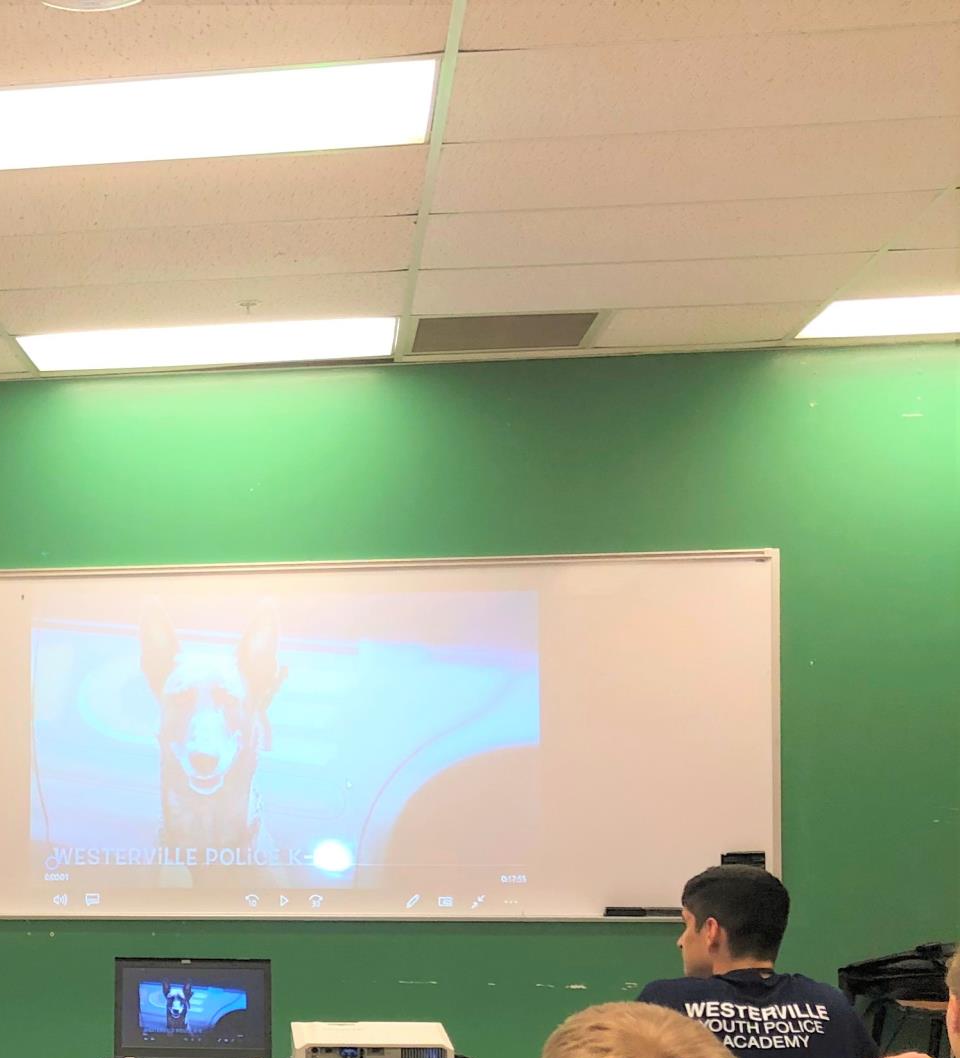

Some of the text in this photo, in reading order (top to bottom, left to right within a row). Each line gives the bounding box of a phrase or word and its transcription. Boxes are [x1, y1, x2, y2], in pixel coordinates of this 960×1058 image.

[684, 1002, 830, 1022] WESTERVILLE
[763, 1020, 825, 1035] POLICE
[723, 1035, 810, 1049] ACADEMY
